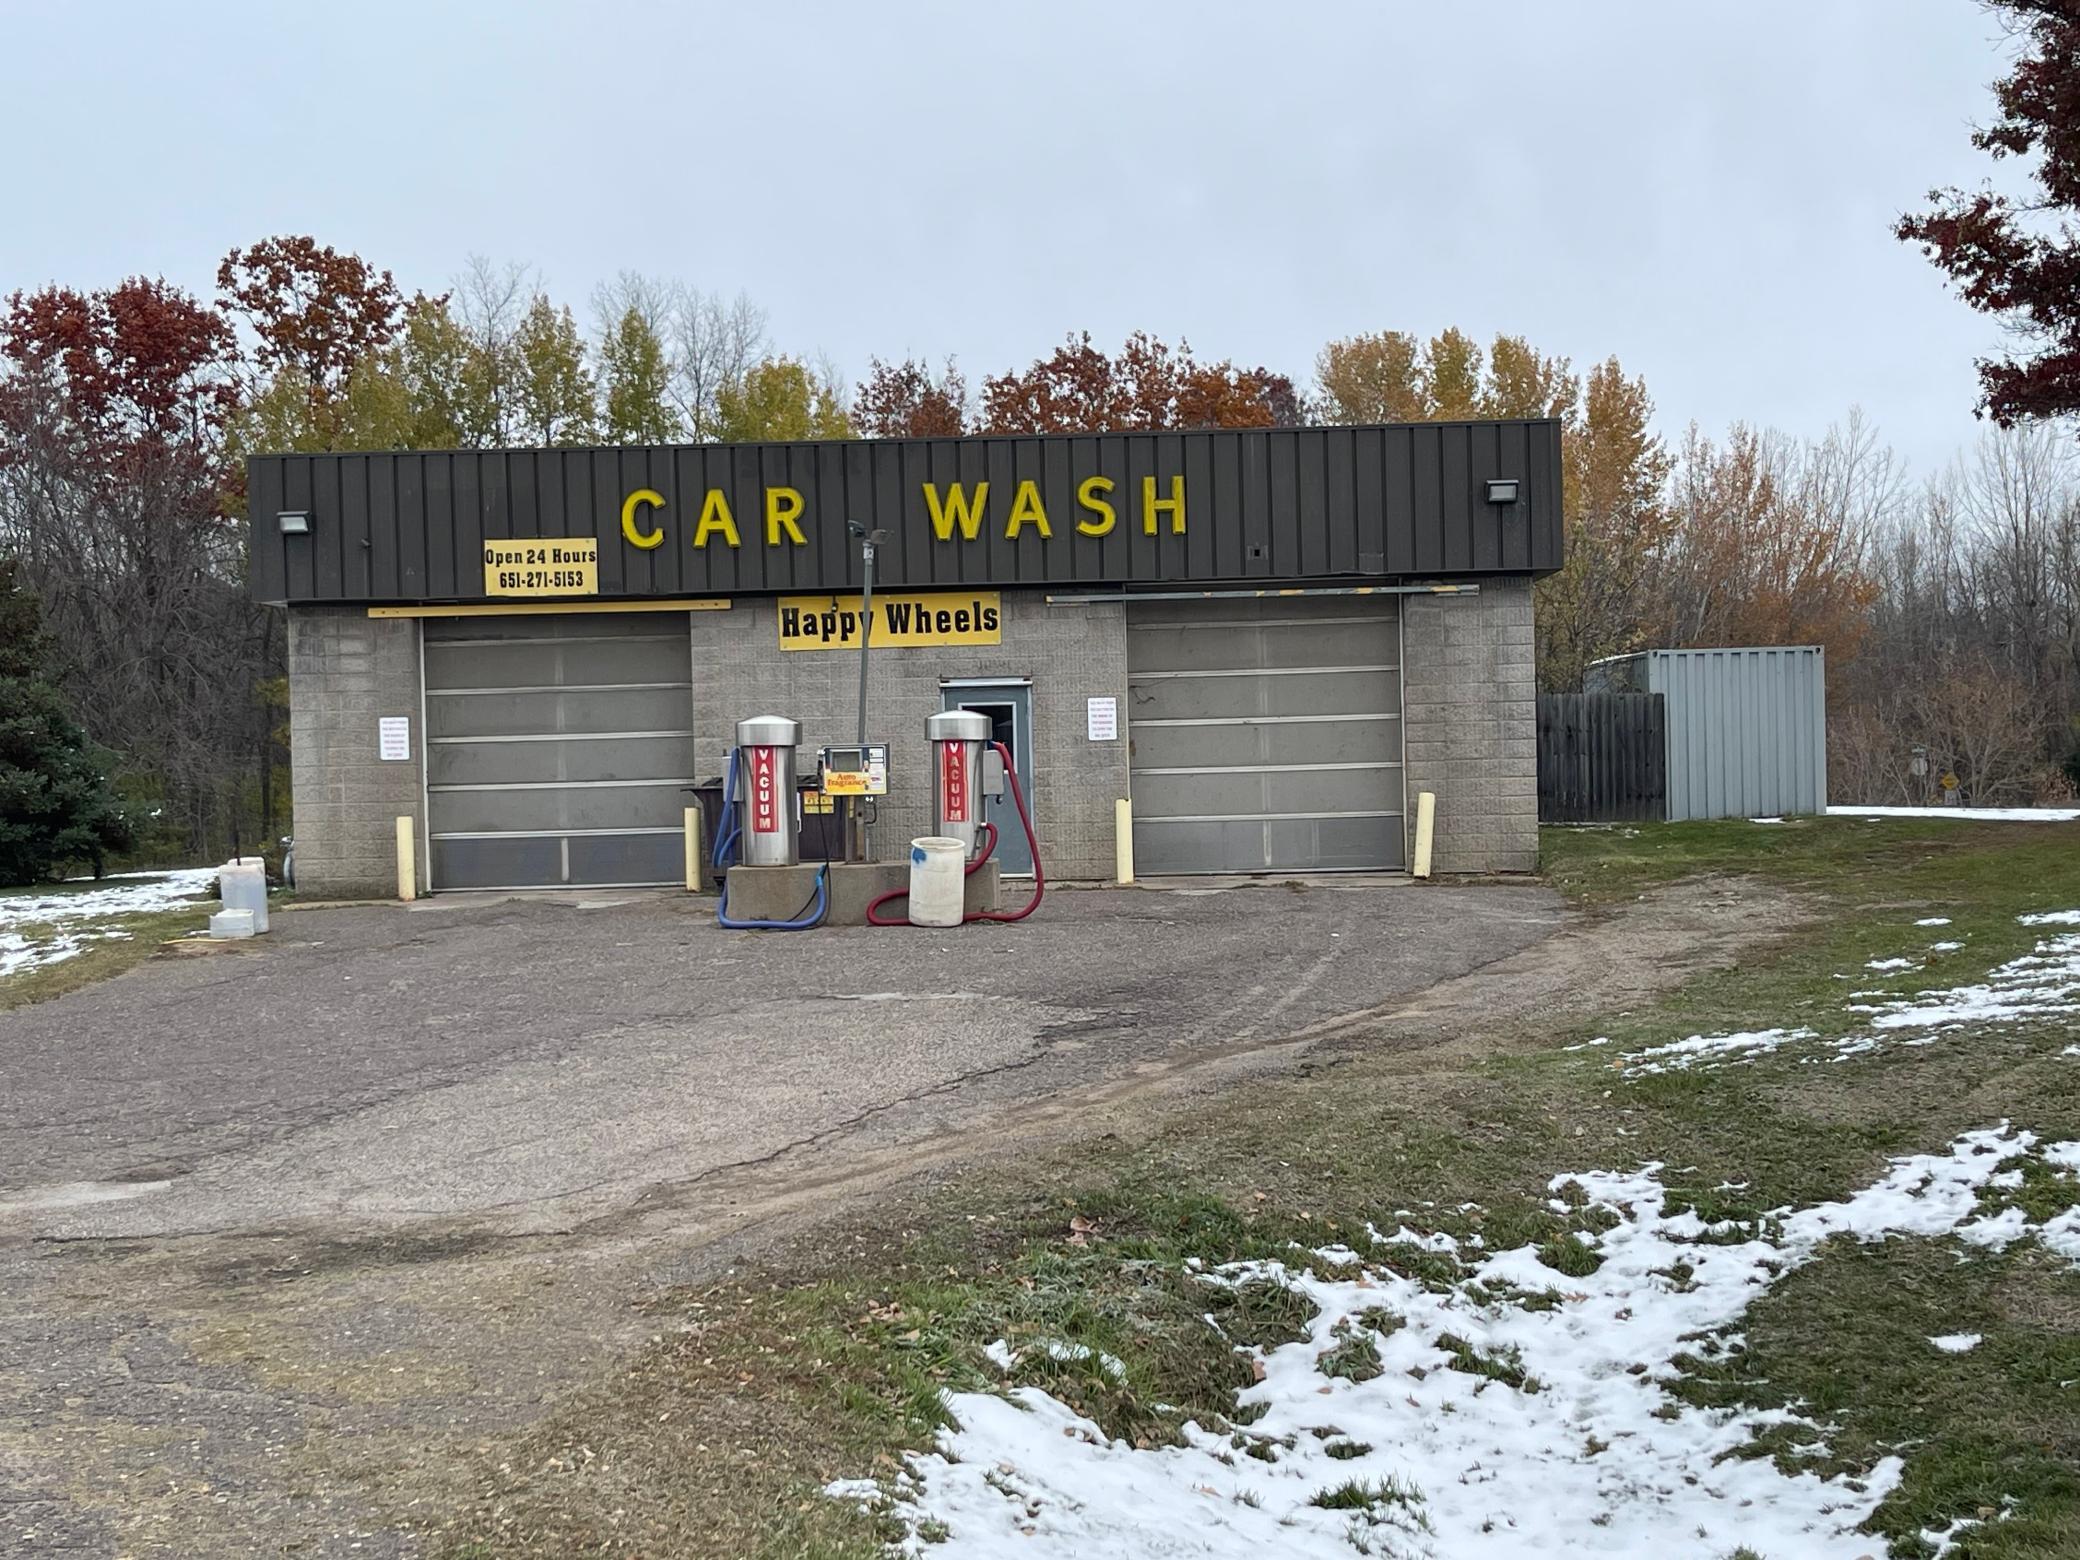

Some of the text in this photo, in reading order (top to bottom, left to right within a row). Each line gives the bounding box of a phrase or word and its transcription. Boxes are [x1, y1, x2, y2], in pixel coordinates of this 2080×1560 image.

[621, 475, 1187, 549] CAR WASH
[486, 548, 596, 568] Open 24 Hours
[500, 570, 583, 588] 651-271-5153
[886, 601, 998, 634] Wheels
[759, 749, 771, 829] VACUUM
[949, 742, 962, 820] VACUUM
